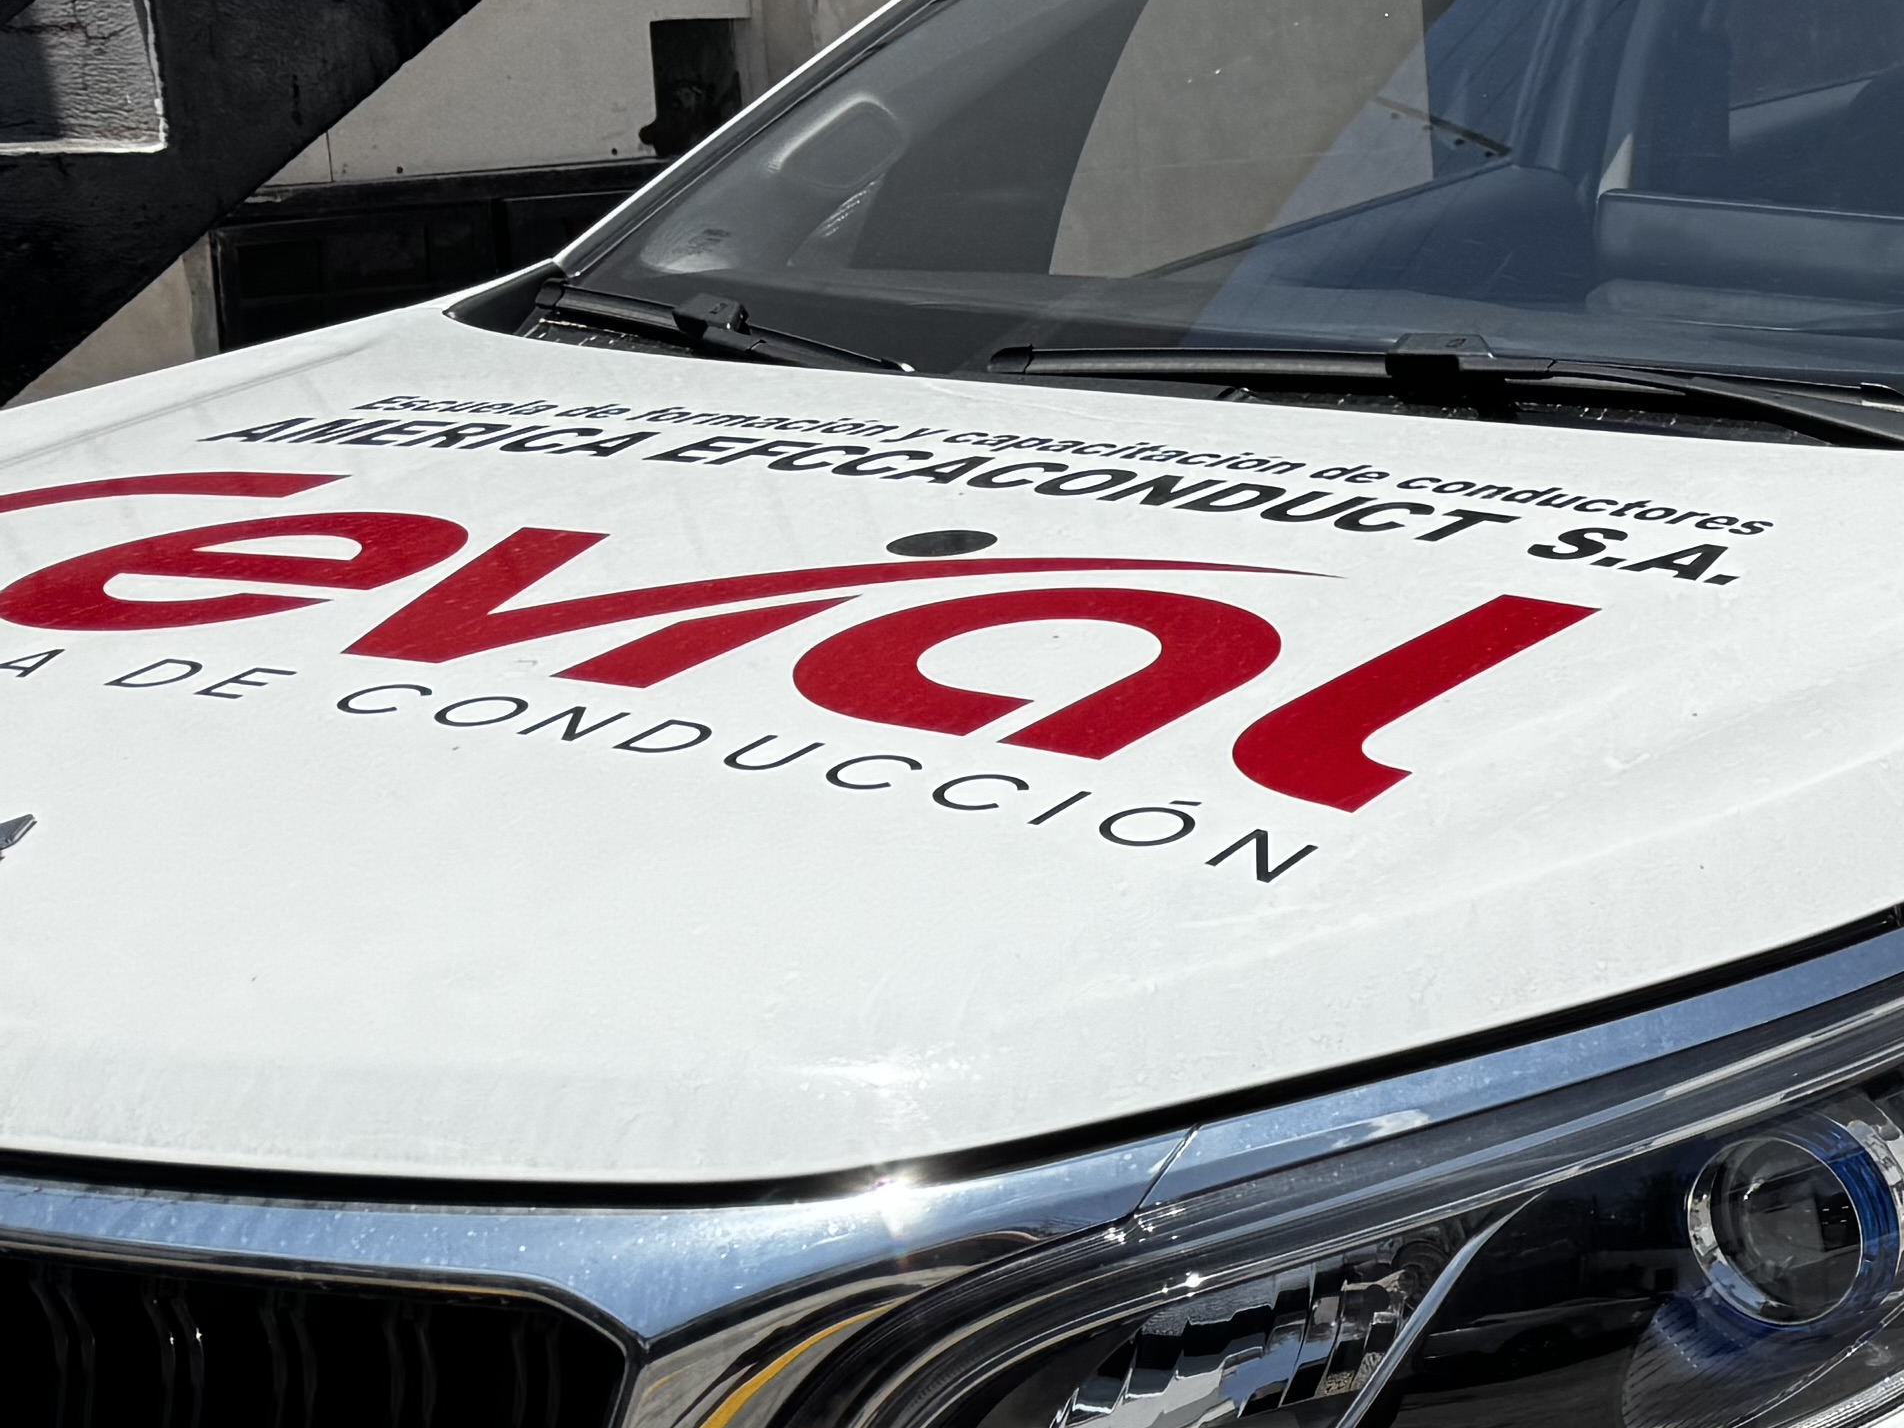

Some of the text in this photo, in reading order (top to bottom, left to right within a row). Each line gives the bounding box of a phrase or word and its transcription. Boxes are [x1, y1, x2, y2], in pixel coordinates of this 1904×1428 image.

[200, 416, 1741, 586] AMERICA EFCCACONDUCT S.A.
[352, 395, 1774, 536] Escuela de formación y capacitación de conductores
[103, 658, 297, 700] DE
[336, 683, 1319, 884] CONDUCCIÓN
